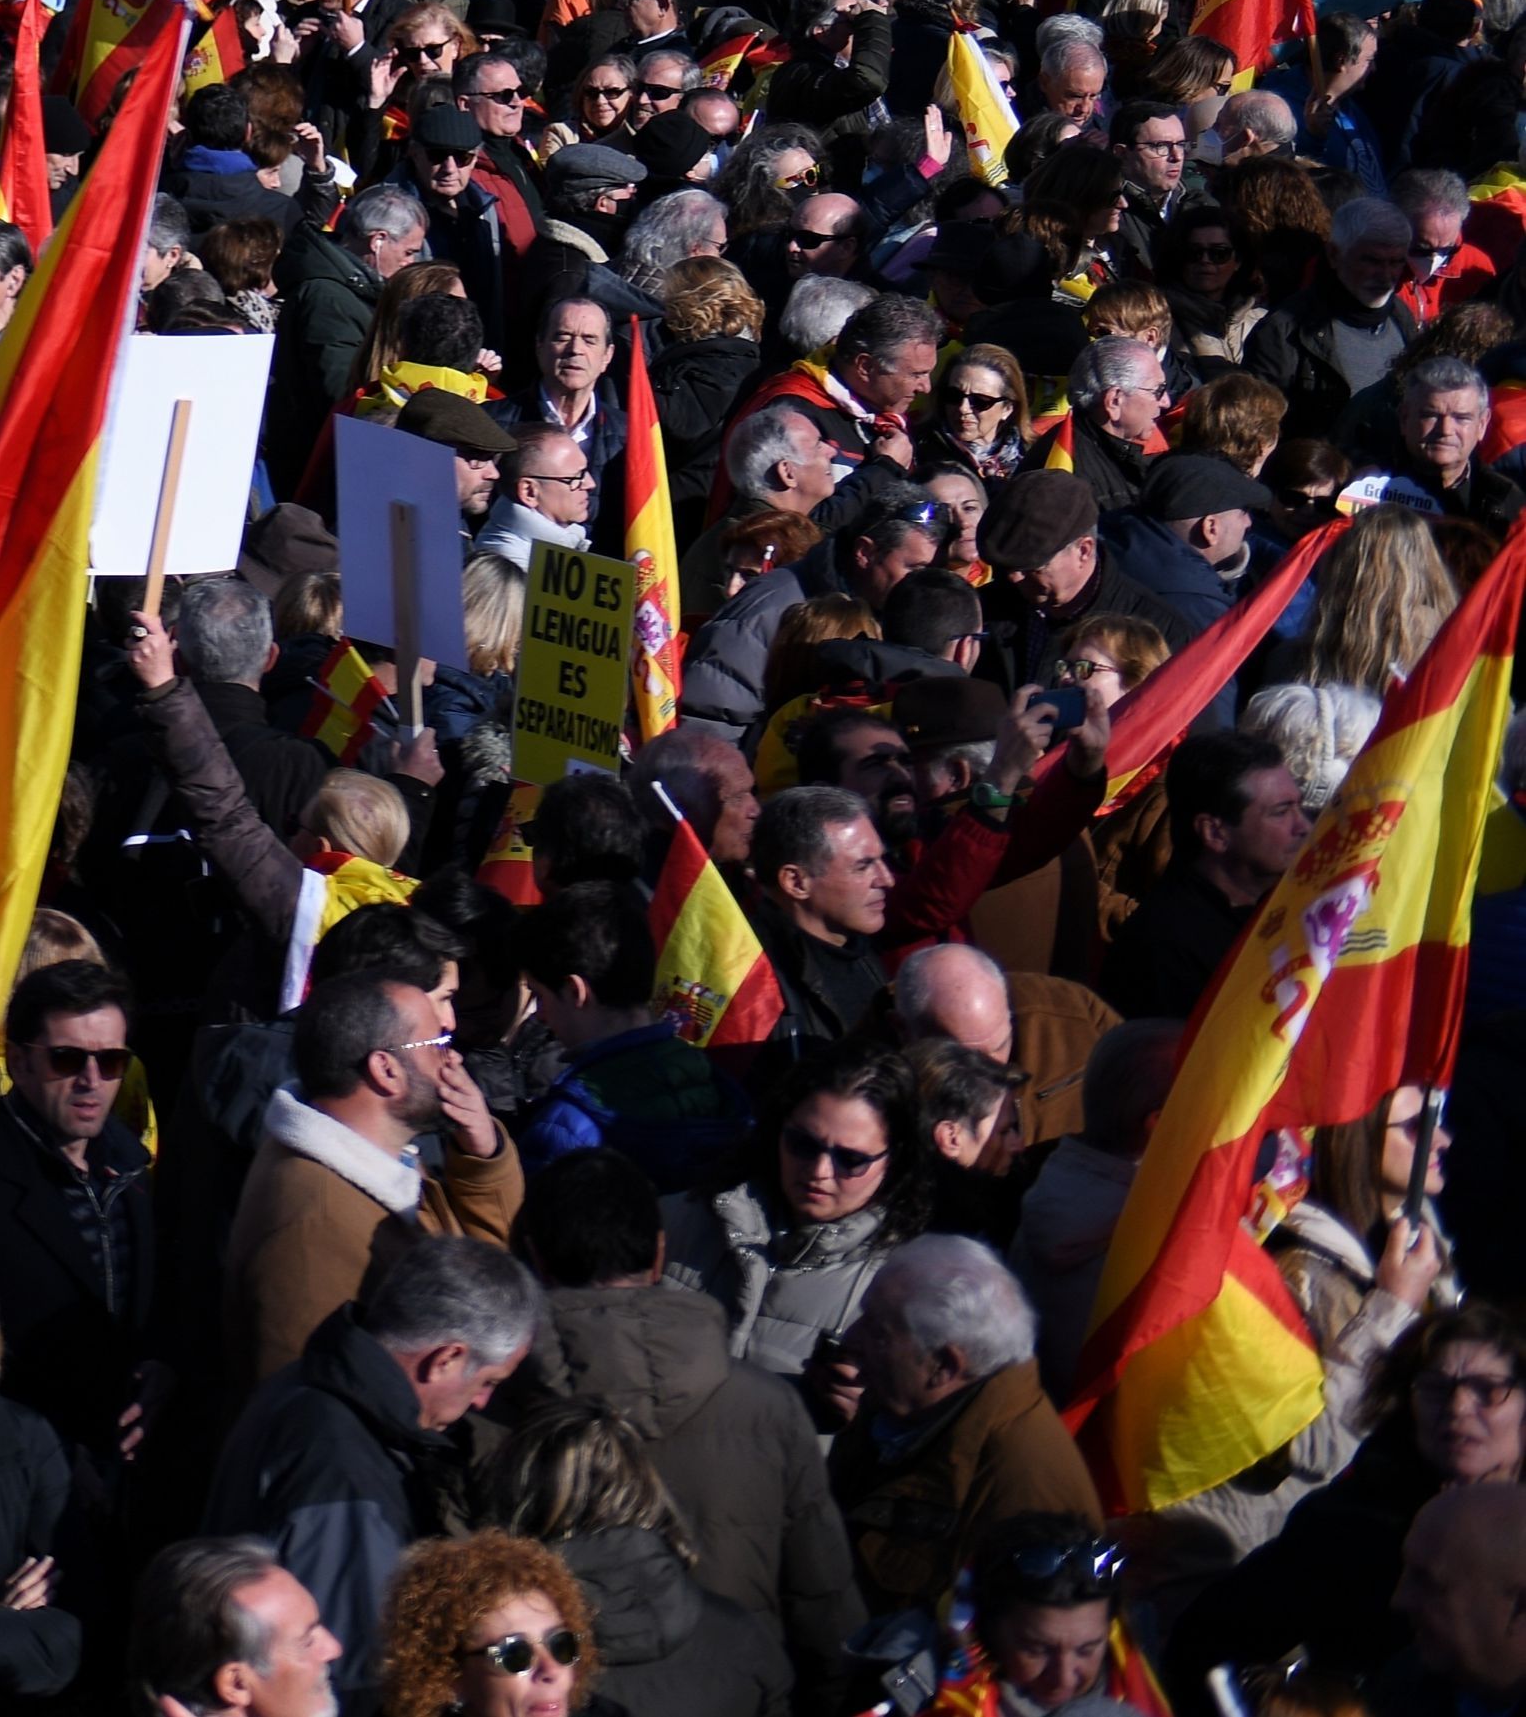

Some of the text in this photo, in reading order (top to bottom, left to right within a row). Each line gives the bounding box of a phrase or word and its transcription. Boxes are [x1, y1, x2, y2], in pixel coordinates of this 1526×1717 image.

[1364, 483, 1435, 511] Gobierno
[542, 549, 621, 612] NO ES
[530, 605, 621, 661] LENGUA
[559, 661, 587, 699] ES
[516, 696, 620, 758] SEPARATISMO
